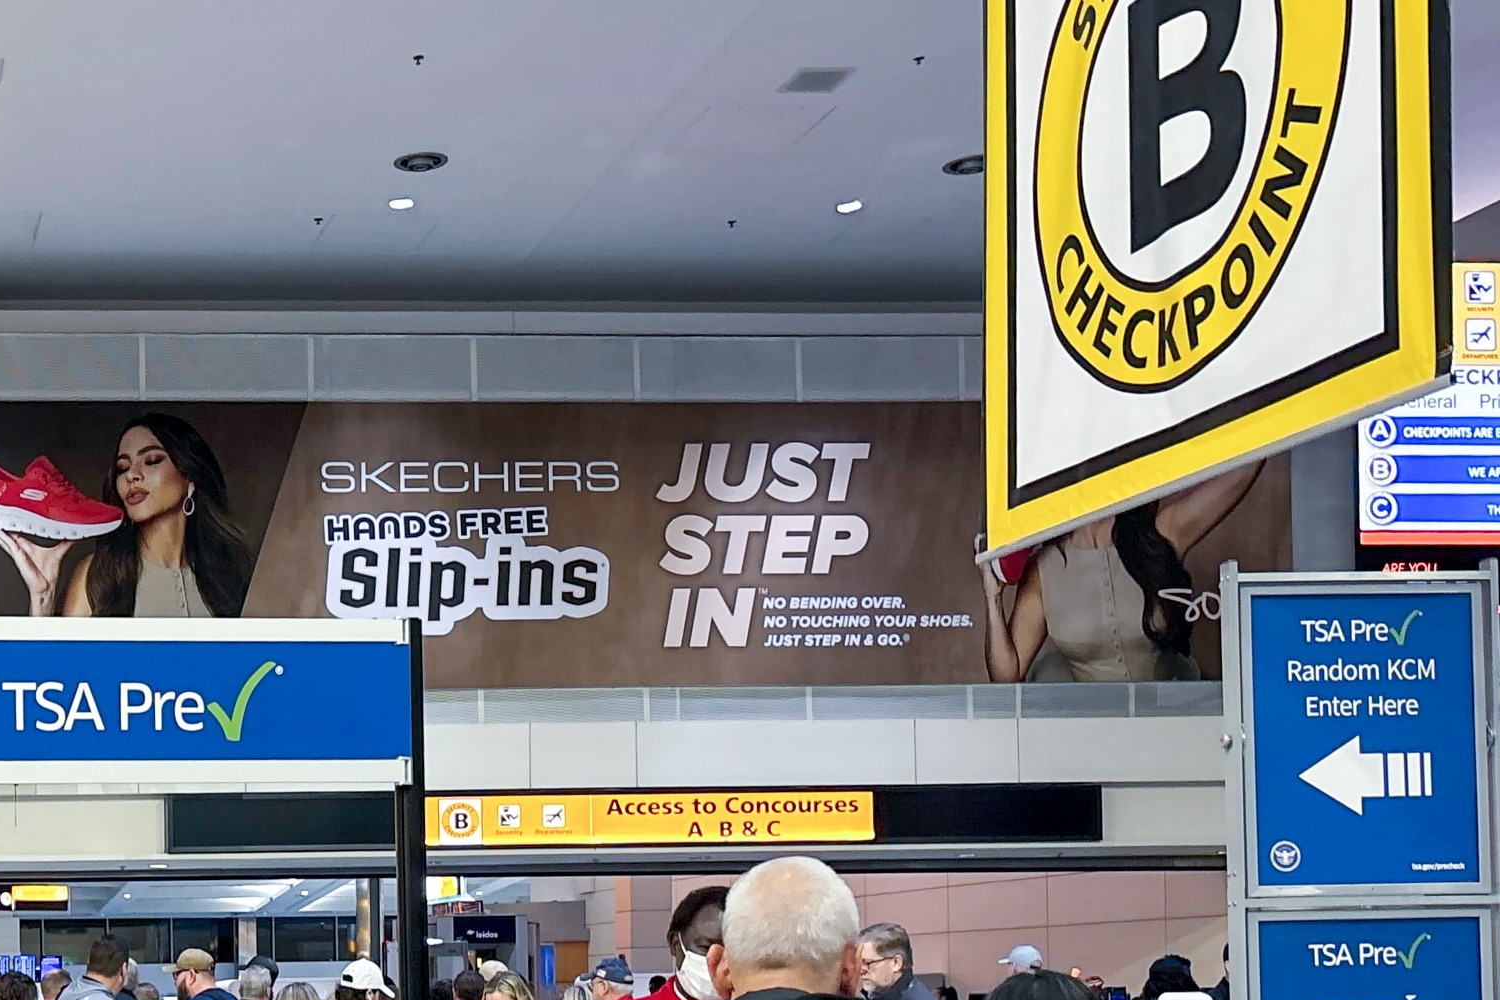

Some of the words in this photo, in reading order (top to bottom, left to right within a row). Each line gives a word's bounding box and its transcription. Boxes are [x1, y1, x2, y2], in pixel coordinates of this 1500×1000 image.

[1127, 0, 1248, 254] B
[1056, 88, 1323, 370] CHECKPOINT
[1403, 425, 1472, 439] CHECKPOINTS
[1473, 426, 1494, 439] ARE
[320, 460, 620, 493] SKECHERS
[656, 441, 871, 503] JUST
[1468, 466, 1486, 479] WE
[327, 514, 448, 541] HANDS
[459, 510, 547, 537] FREE
[659, 513, 869, 575] STEP
[1382, 563, 1406, 574] ARE
[340, 546, 600, 623] Slip-ins
[763, 598, 786, 609] NO
[790, 597, 856, 610] BENDING
[860, 597, 906, 609] OVER.
[763, 616, 786, 628] NO
[790, 615, 871, 628] TOUCHING
[874, 615, 916, 628] YOUR
[919, 614, 973, 627] SHOES.
[1301, 620, 1345, 642] TSA
[1351, 619, 1388, 642] Pre
[763, 634, 801, 647] JUST
[805, 634, 843, 647] STEP
[847, 634, 860, 647] IN
[863, 634, 874, 646] &
[1288, 658, 1380, 682] Random
[1387, 658, 1436, 681] KCM
[2, 682, 105, 732] TSA
[120, 682, 205, 732] Pre
[1306, 696, 1361, 717] Enter
[1368, 695, 1420, 716] Here
[607, 799, 684, 815] Access
[694, 799, 717, 814] to
[725, 797, 859, 814] Concourses
[455, 813, 469, 829] B
[535, 828, 573, 836] Departures
[688, 821, 703, 837] A
[719, 821, 732, 837] B
[742, 821, 758, 836] &
[767, 820, 781, 837] C
[495, 829, 523, 837] Security
[1309, 943, 1354, 967] TSA
[1359, 943, 1397, 966] Pre
